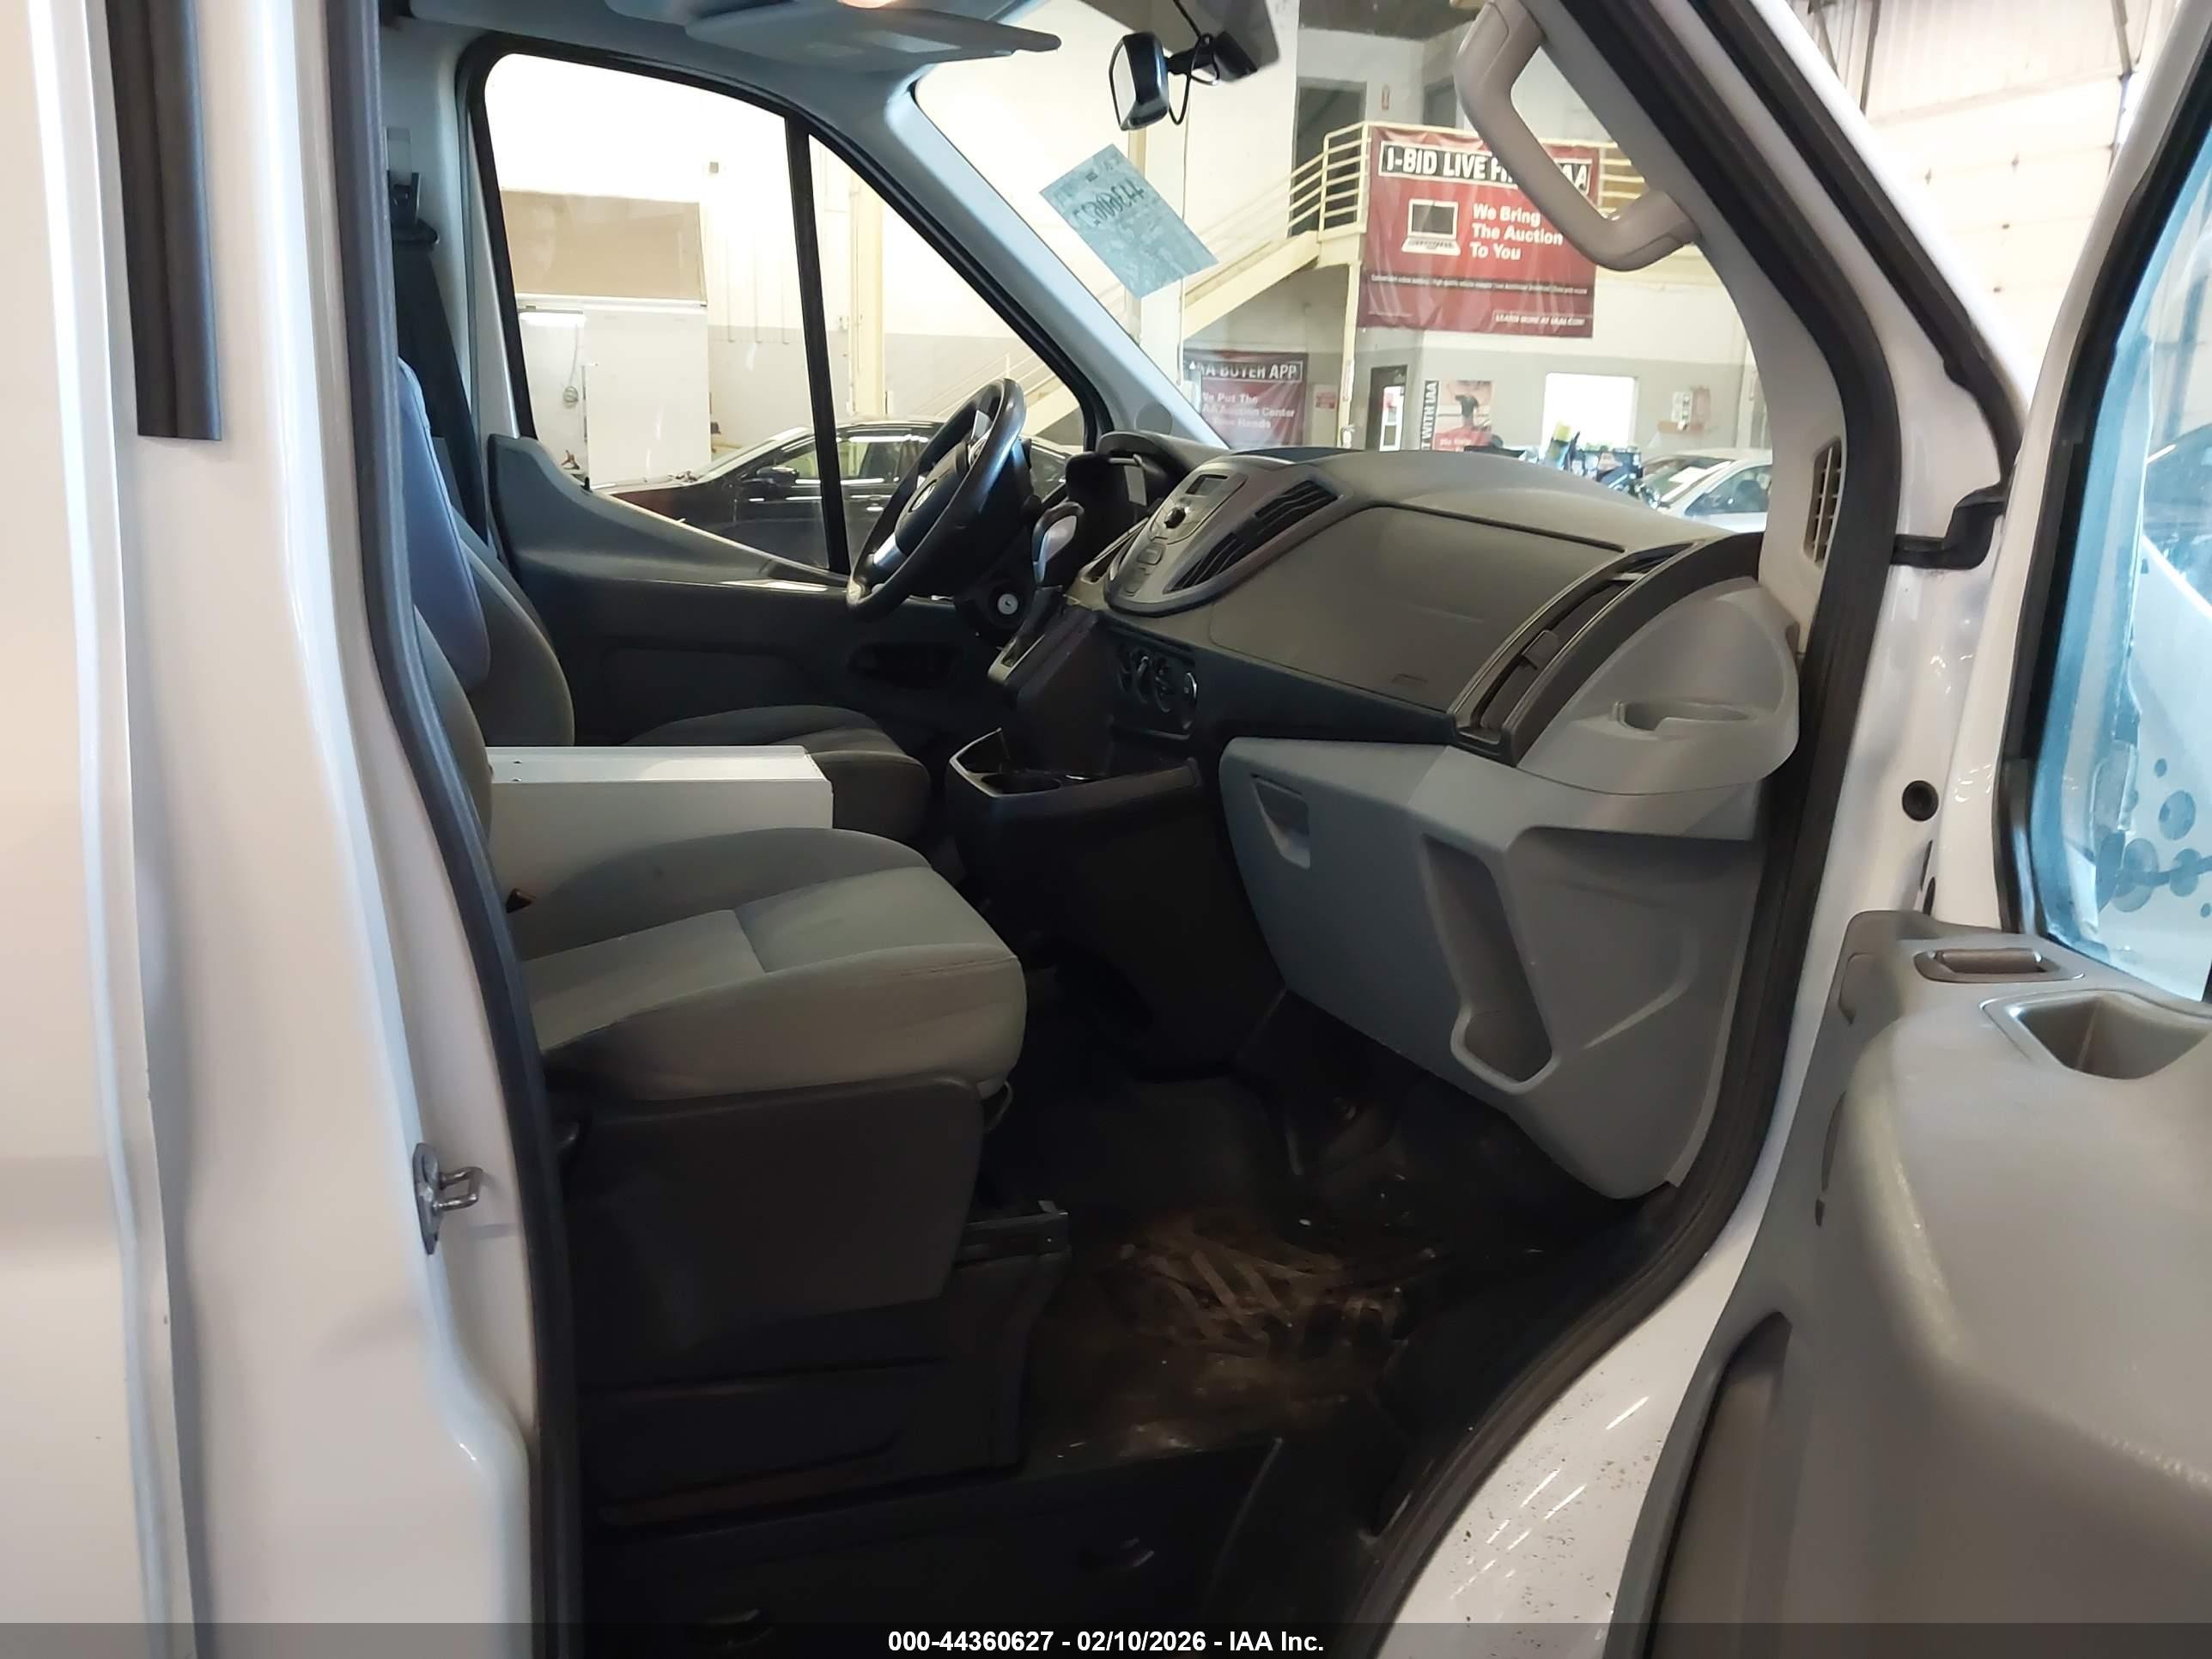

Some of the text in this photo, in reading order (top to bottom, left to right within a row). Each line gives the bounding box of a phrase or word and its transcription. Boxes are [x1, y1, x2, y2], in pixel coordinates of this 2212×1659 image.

[1386, 147, 1437, 175] I-BID
[1443, 151, 1486, 179] LIVE
[1473, 203, 1541, 228] We Bring
[1471, 222, 1564, 246] The Auction
[1469, 241, 1522, 260] To You
[1269, 364, 1297, 379] APP
